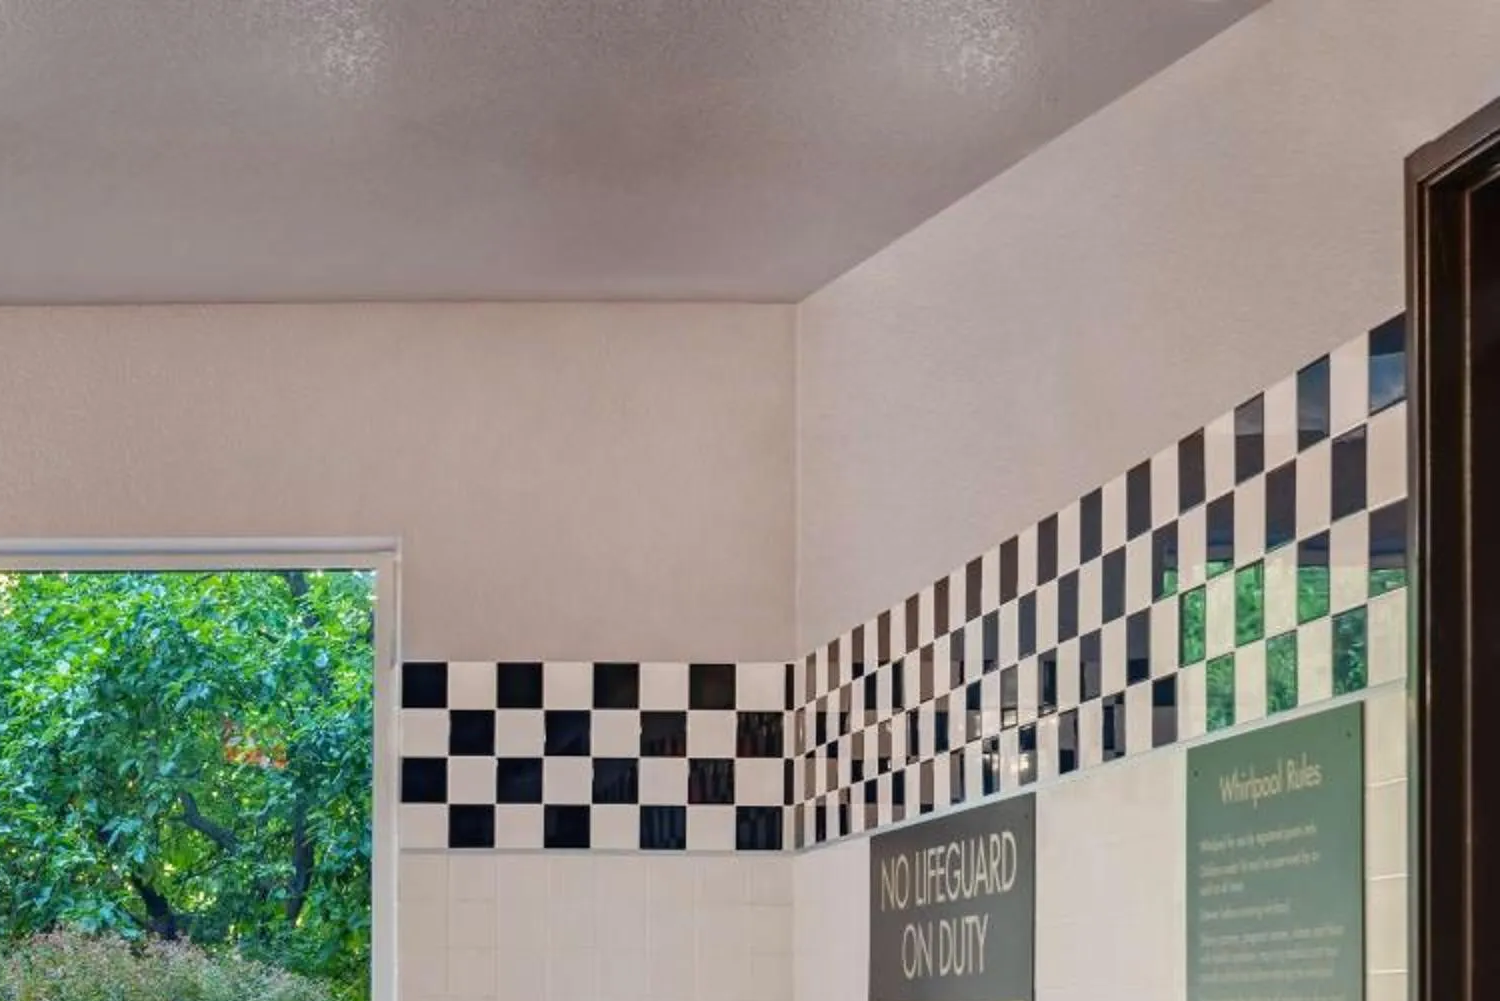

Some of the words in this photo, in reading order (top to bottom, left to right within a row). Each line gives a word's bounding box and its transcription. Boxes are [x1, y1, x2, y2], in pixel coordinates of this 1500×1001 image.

[1219, 757, 1281, 810] Whirlpool
[1287, 753, 1322, 792] Rules
[881, 854, 911, 911] NO
[915, 831, 1017, 905] LIFEGUARD
[901, 921, 933, 980] ON
[939, 912, 989, 976] DUTY
